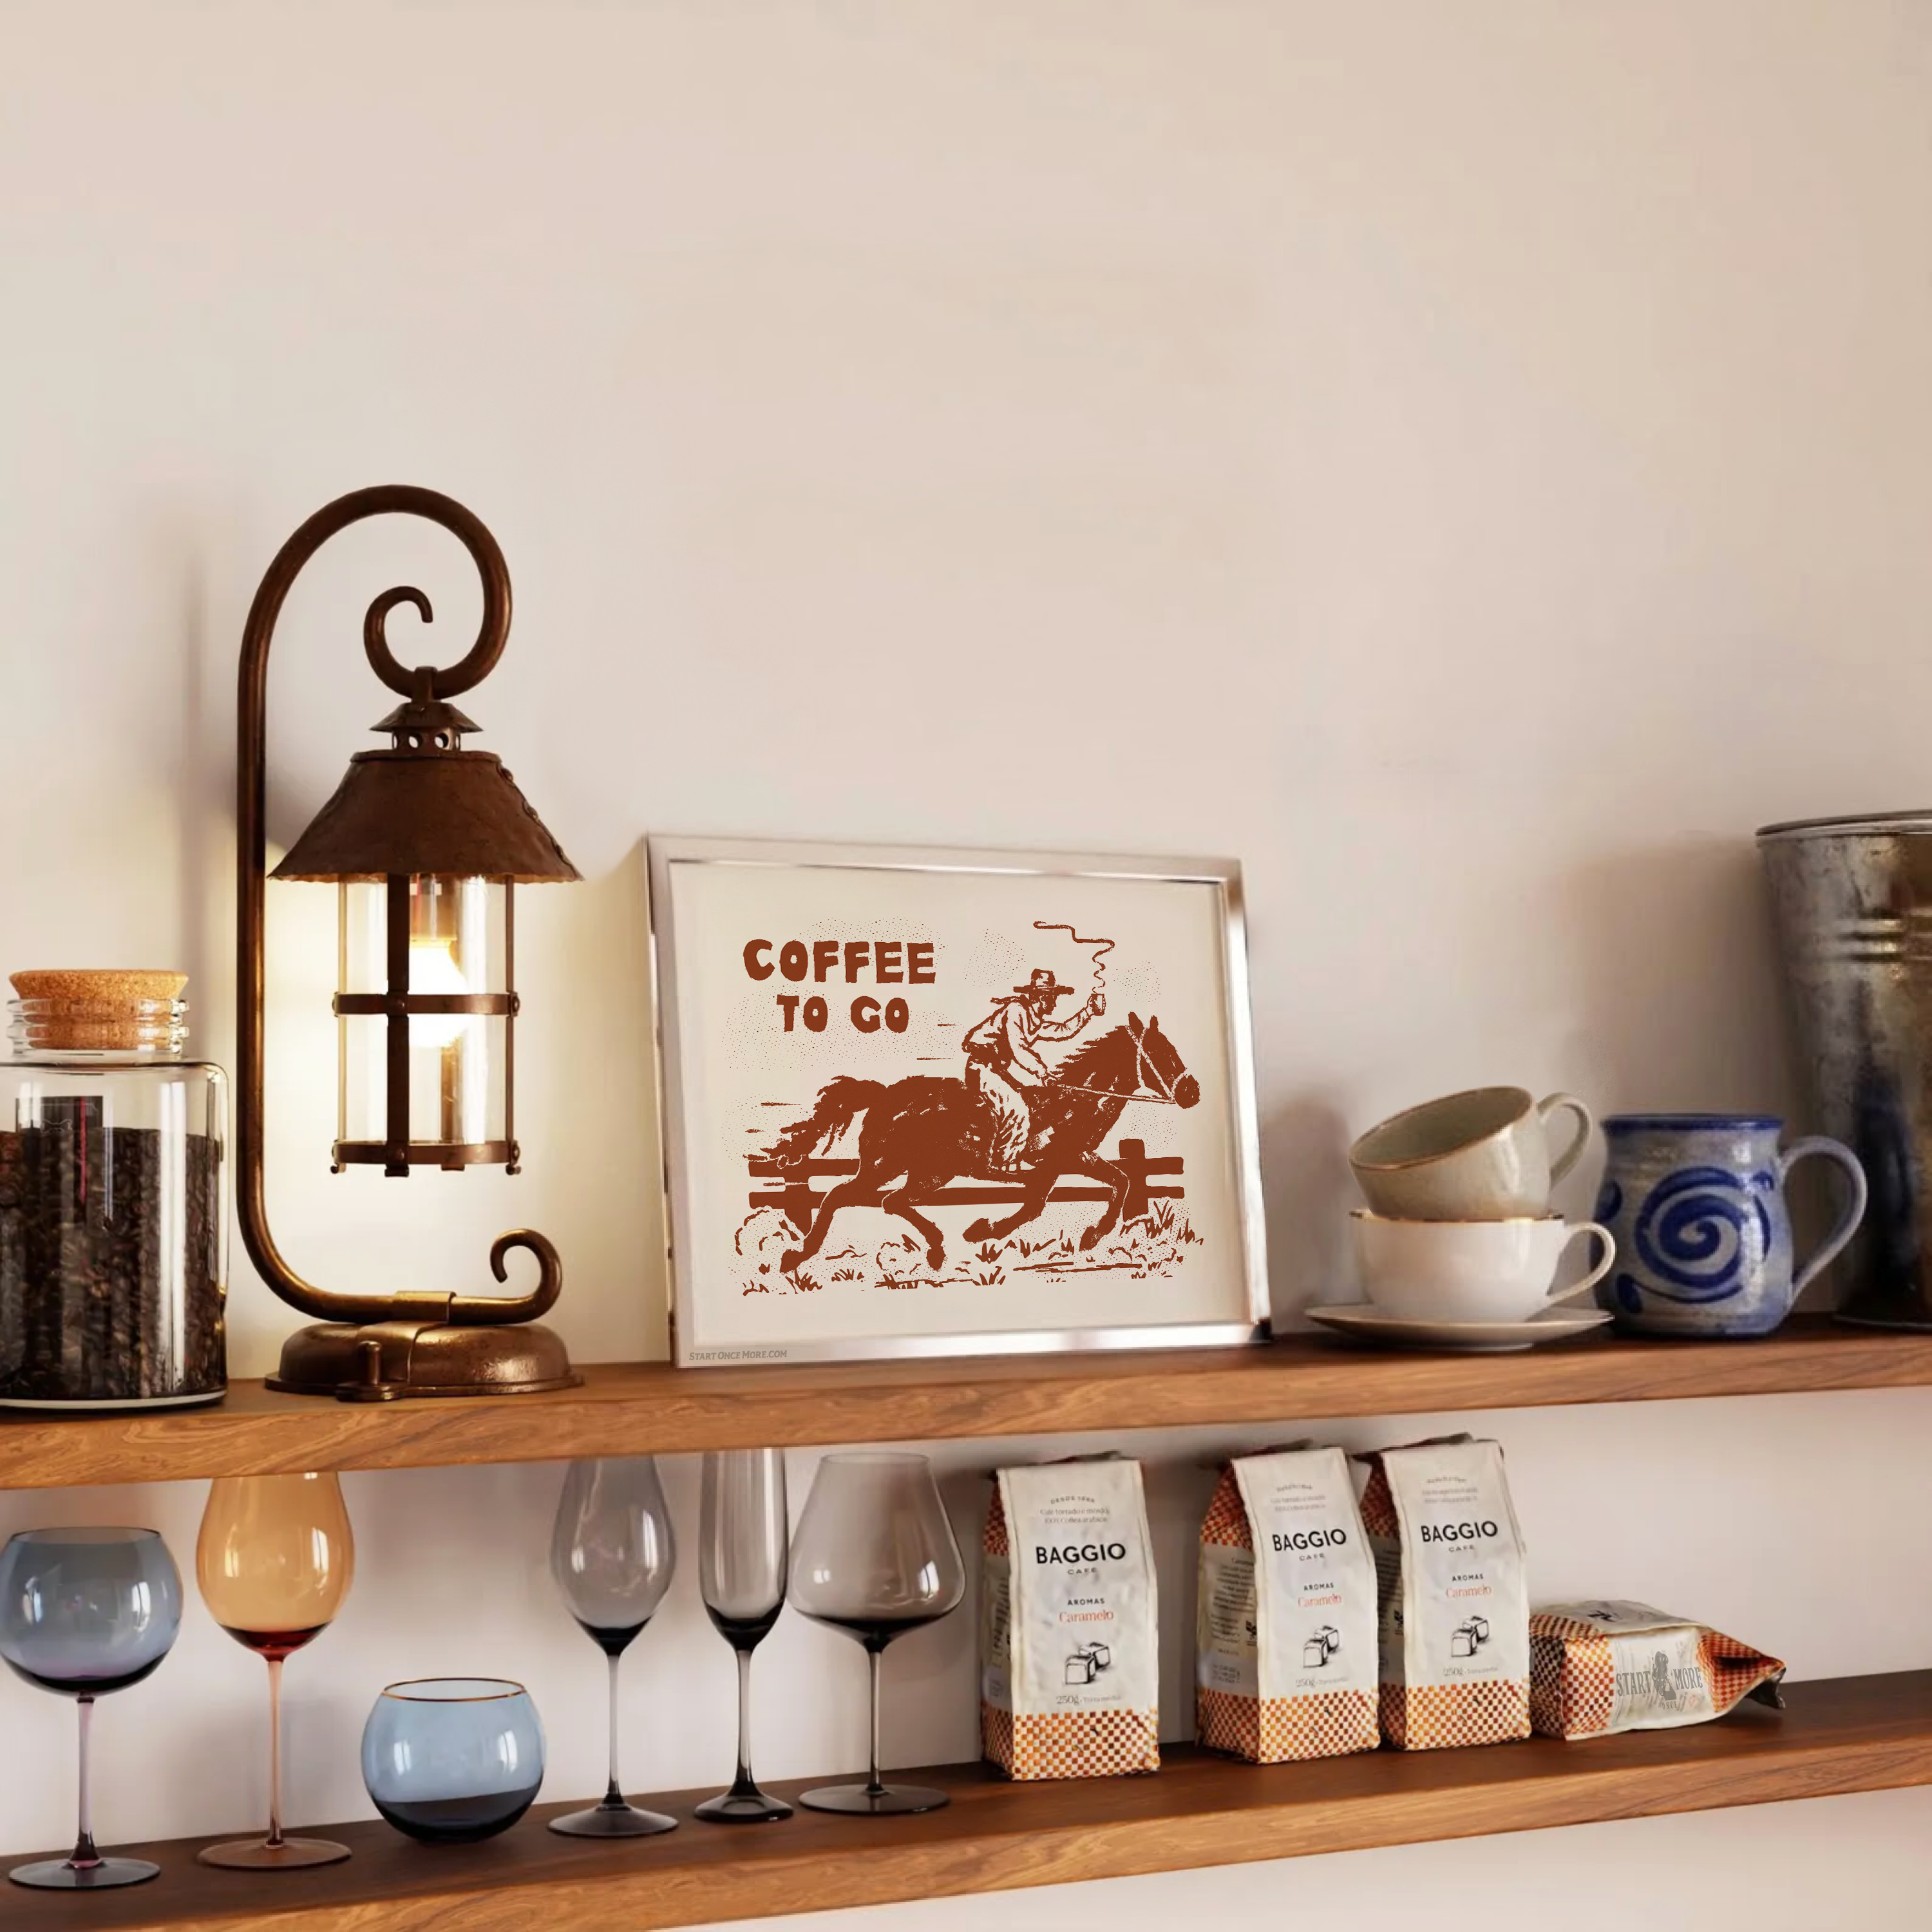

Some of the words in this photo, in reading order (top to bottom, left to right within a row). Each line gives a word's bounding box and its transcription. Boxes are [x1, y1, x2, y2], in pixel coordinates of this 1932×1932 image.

[743, 938, 936, 984] COFFEE
[776, 994, 828, 1032] TO
[850, 996, 909, 1033] GO
[1421, 1520, 1499, 1542] BAGGIO
[1273, 1528, 1347, 1551] BAGGIO
[1036, 1543, 1126, 1564] BAGGIO
[1452, 1573, 1484, 1582] AROMAS
[1303, 1582, 1334, 1591] AROMAS
[1445, 1584, 1492, 1598] Caramelo
[1298, 1593, 1342, 1607] Caramelo
[1059, 1609, 1114, 1622] Caramelo
[1056, 1695, 1079, 1705] 250g
